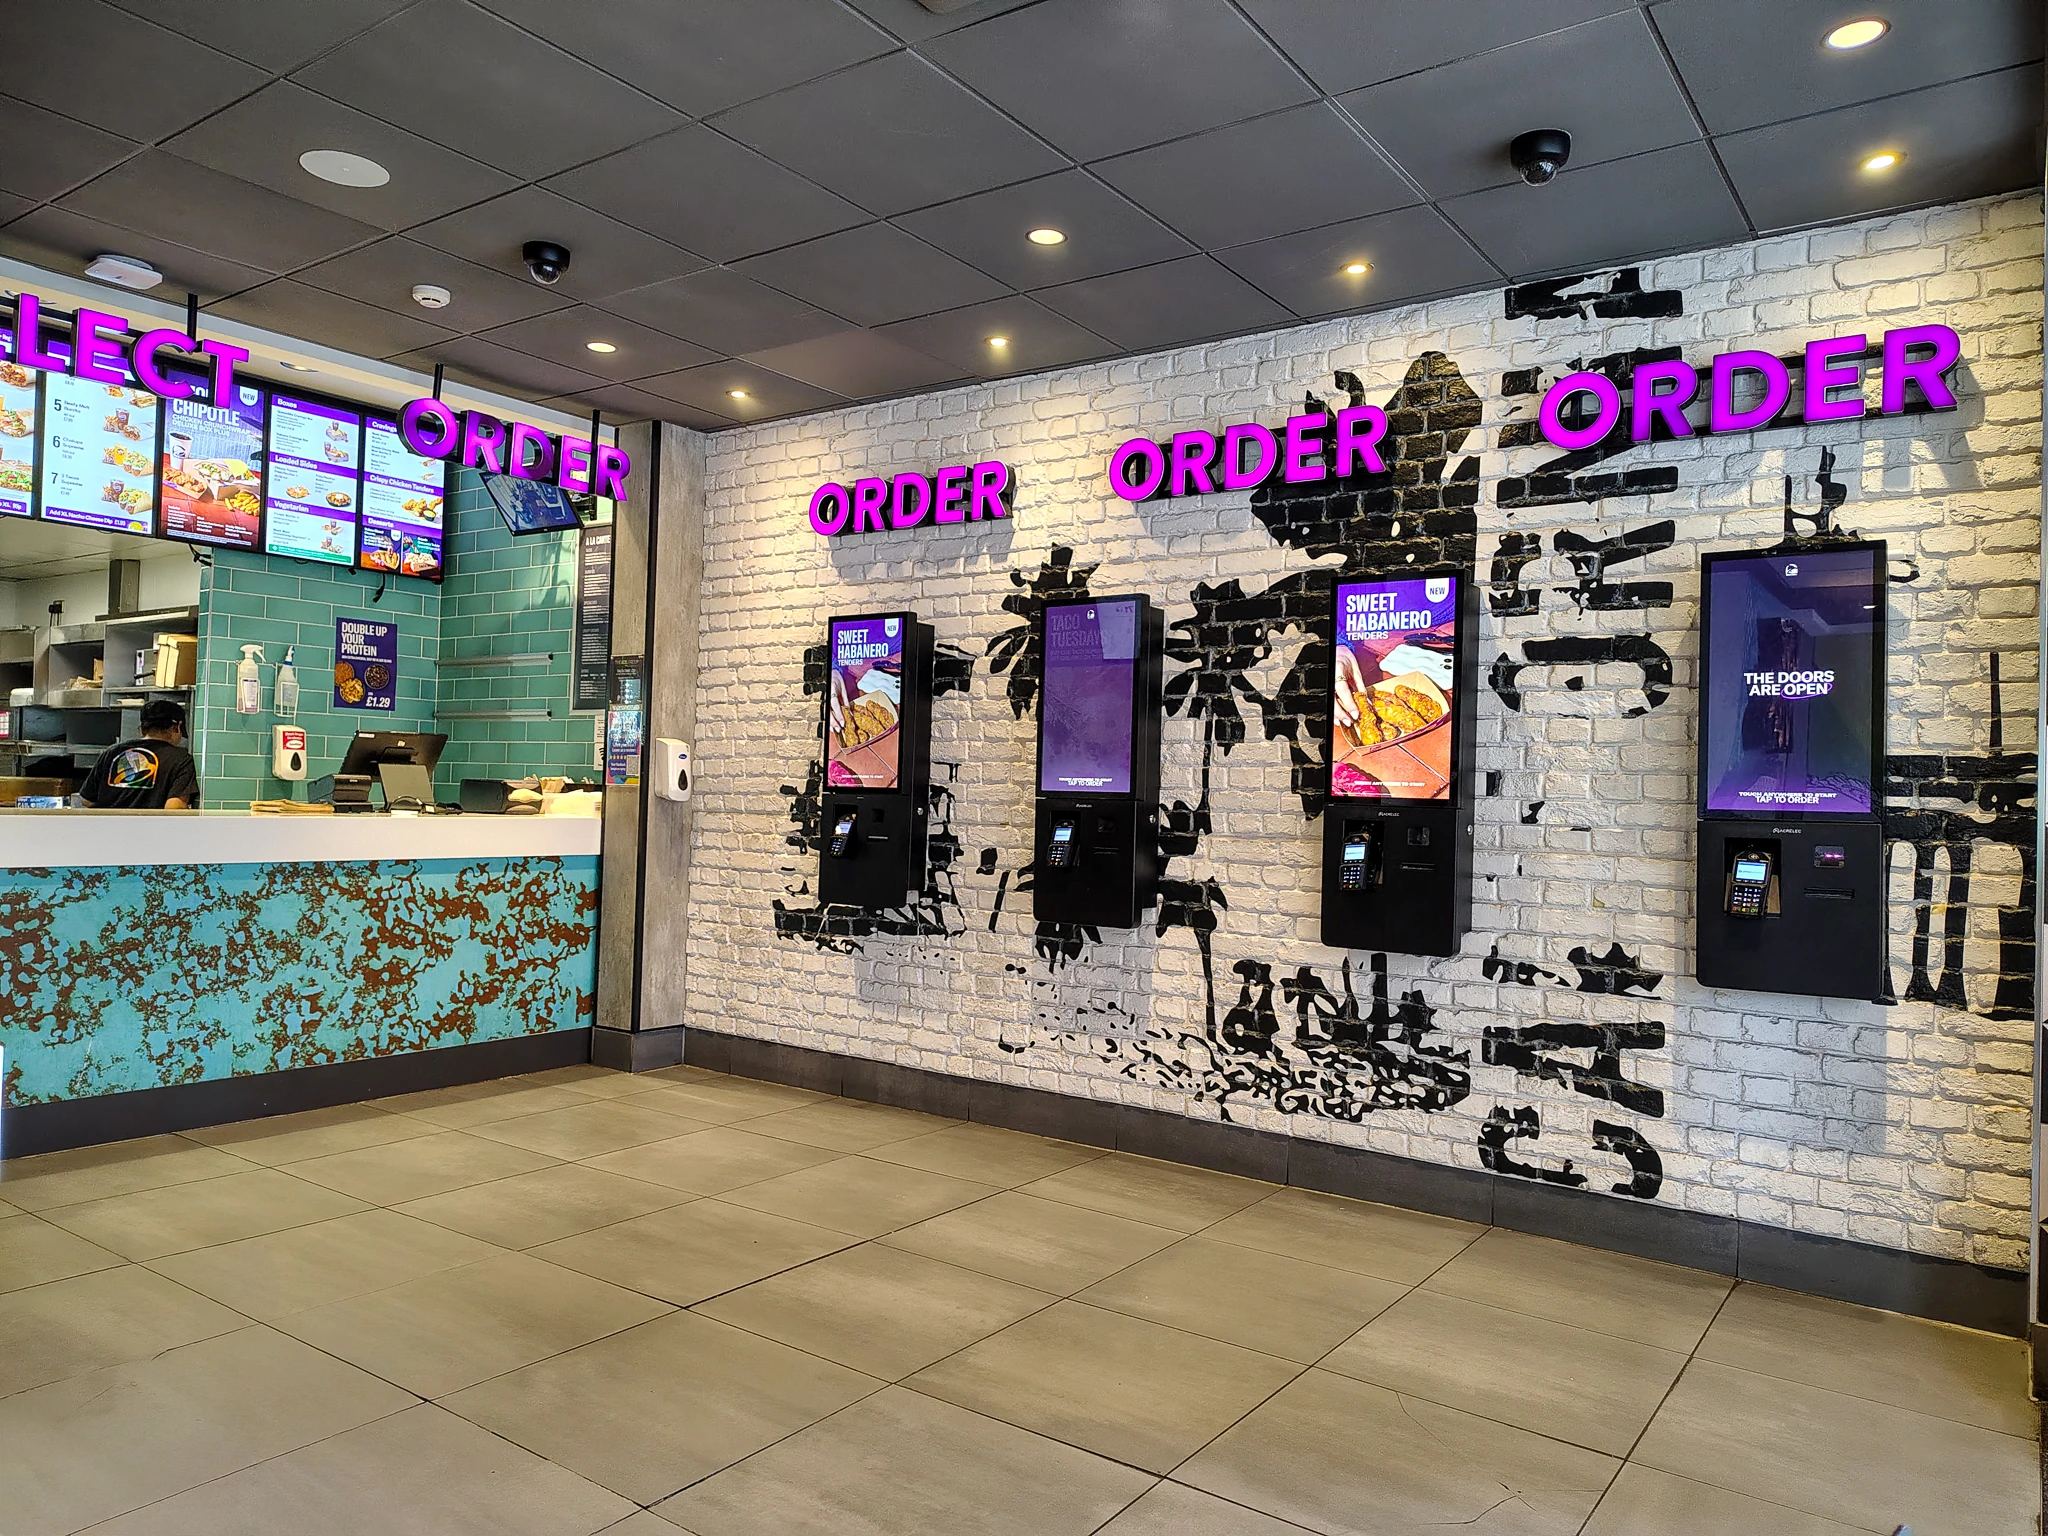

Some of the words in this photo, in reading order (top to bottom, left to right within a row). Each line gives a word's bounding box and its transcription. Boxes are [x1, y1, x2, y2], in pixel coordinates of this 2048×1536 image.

[0, 292, 249, 409] LECT
[1538, 323, 1961, 451] ORDER
[242, 393, 256, 401] NEW
[277, 398, 298, 409] Boxes
[53, 398, 62, 412] 5
[172, 398, 240, 426] CHIPOTLE
[52, 435, 61, 448] 6
[400, 397, 631, 502] ORDER
[1108, 405, 1389, 502] ORDER
[275, 454, 299, 466] Loaded
[299, 460, 318, 469] Sides
[51, 472, 59, 484] 7
[369, 474, 389, 485] Crispy
[388, 479, 412, 490] Chicken
[412, 483, 435, 494] Tenders
[273, 499, 310, 513] Vegetarian
[808, 461, 1011, 536] ORDER
[1429, 587, 1446, 596] NEW
[1345, 592, 1398, 613] SWEET
[1051, 614, 1080, 631] TACO
[1345, 609, 1432, 632] HABANERO
[341, 622, 375, 636] DOUBLE
[375, 626, 388, 637] UP
[837, 629, 869, 645] SWEET
[1345, 631, 1389, 641] TENDERS
[341, 633, 365, 645] YOUR
[341, 643, 378, 657] PROTEIN
[837, 642, 889, 659] HABANERO
[837, 658, 864, 667] TENDERS
[1743, 672, 1775, 685] THE
[1777, 670, 1835, 684] DOORS
[1748, 684, 1781, 697] ARE
[1783, 682, 1829, 696] OPEN
[365, 696, 391, 708] £1.29
[1775, 796, 1787, 804] TO
[1787, 796, 1820, 804] ORDER
